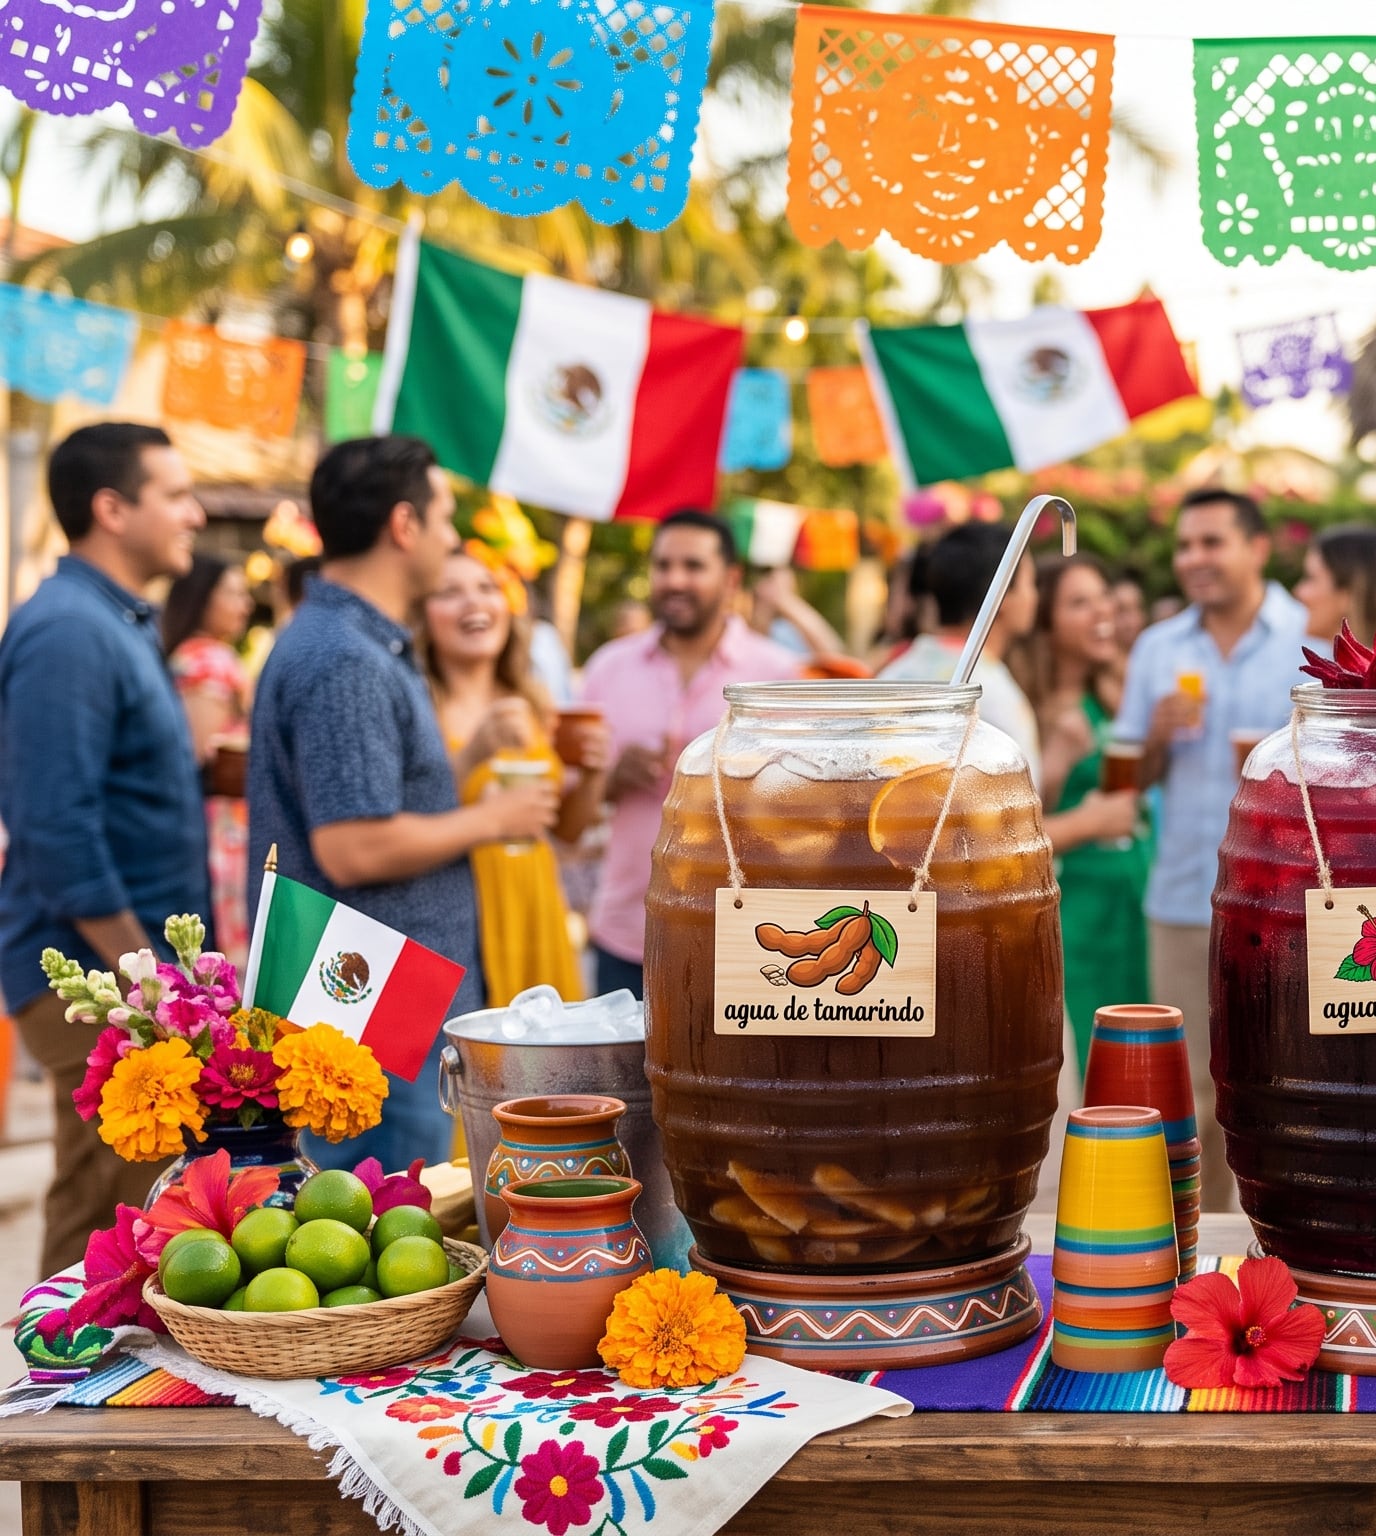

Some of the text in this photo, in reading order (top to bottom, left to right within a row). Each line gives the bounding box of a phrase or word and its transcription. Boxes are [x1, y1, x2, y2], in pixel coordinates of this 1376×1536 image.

[724, 995, 925, 1030] agua de tamarindo
